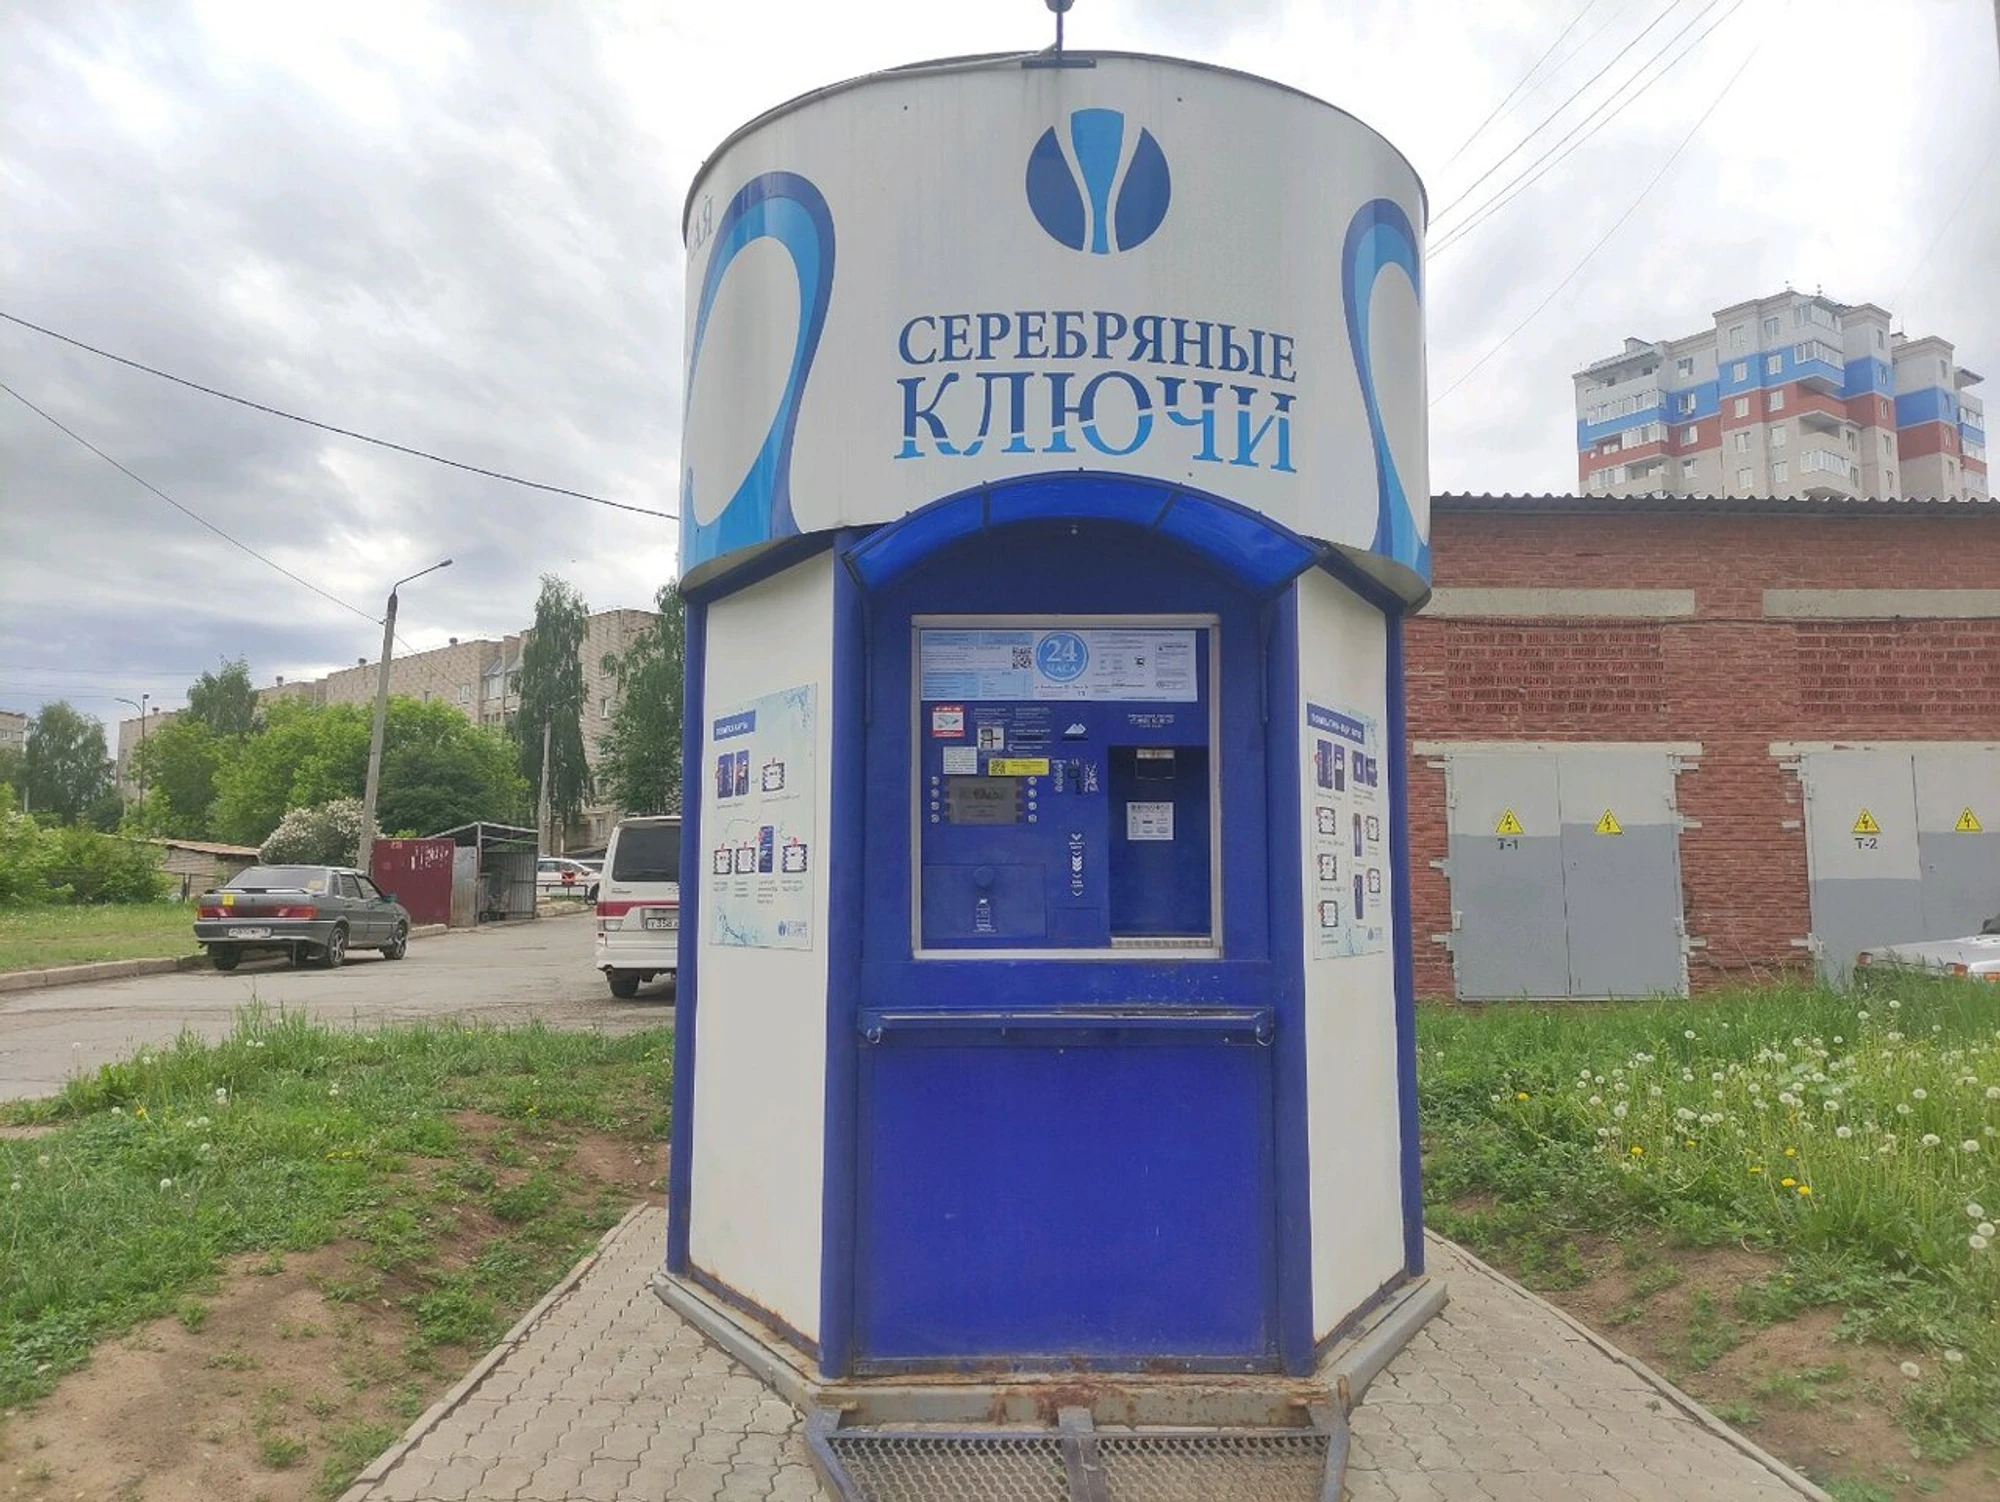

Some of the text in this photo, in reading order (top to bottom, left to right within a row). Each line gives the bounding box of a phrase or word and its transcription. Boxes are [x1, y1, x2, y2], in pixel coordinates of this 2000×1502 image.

[898, 310, 1298, 382] СЕРЕБРЯНЫЕ
[894, 370, 1298, 474] КЛЮЧИ
[1046, 640, 1078, 661] 24
[1854, 837, 1878, 850] Т-2
